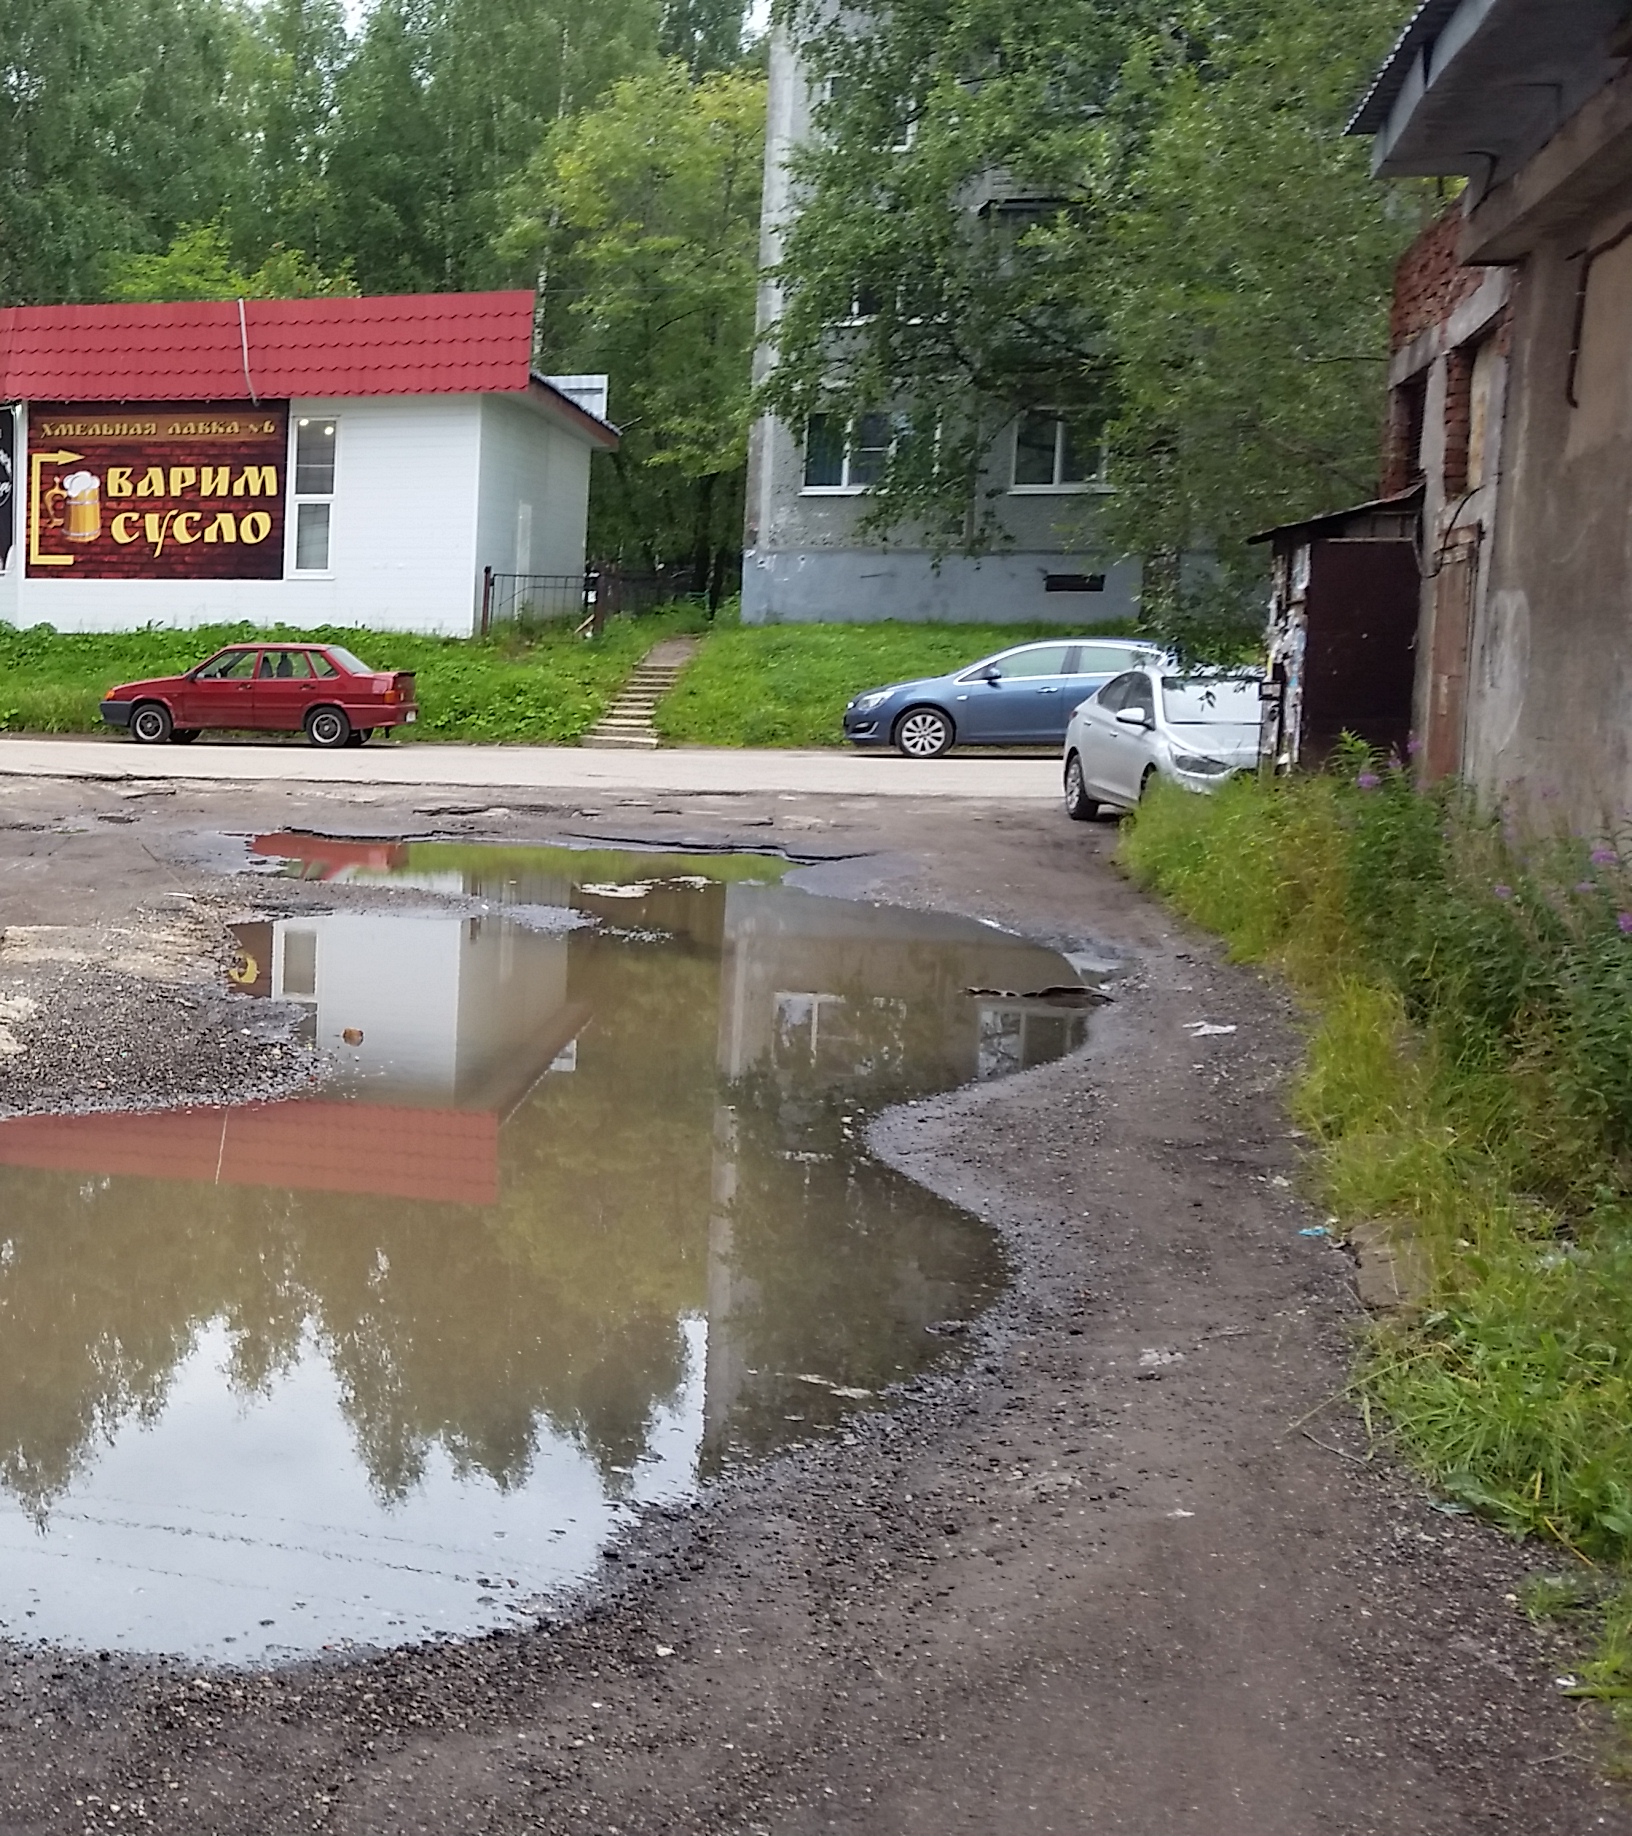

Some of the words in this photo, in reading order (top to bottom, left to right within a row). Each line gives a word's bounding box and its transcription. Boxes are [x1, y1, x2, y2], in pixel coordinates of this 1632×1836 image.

[40, 421, 158, 439] ХМЕЛЬНАЯ
[167, 420, 241, 435] ЛАВКА
[106, 465, 278, 498] ВАРИМ
[110, 508, 273, 558] СУСЛО
